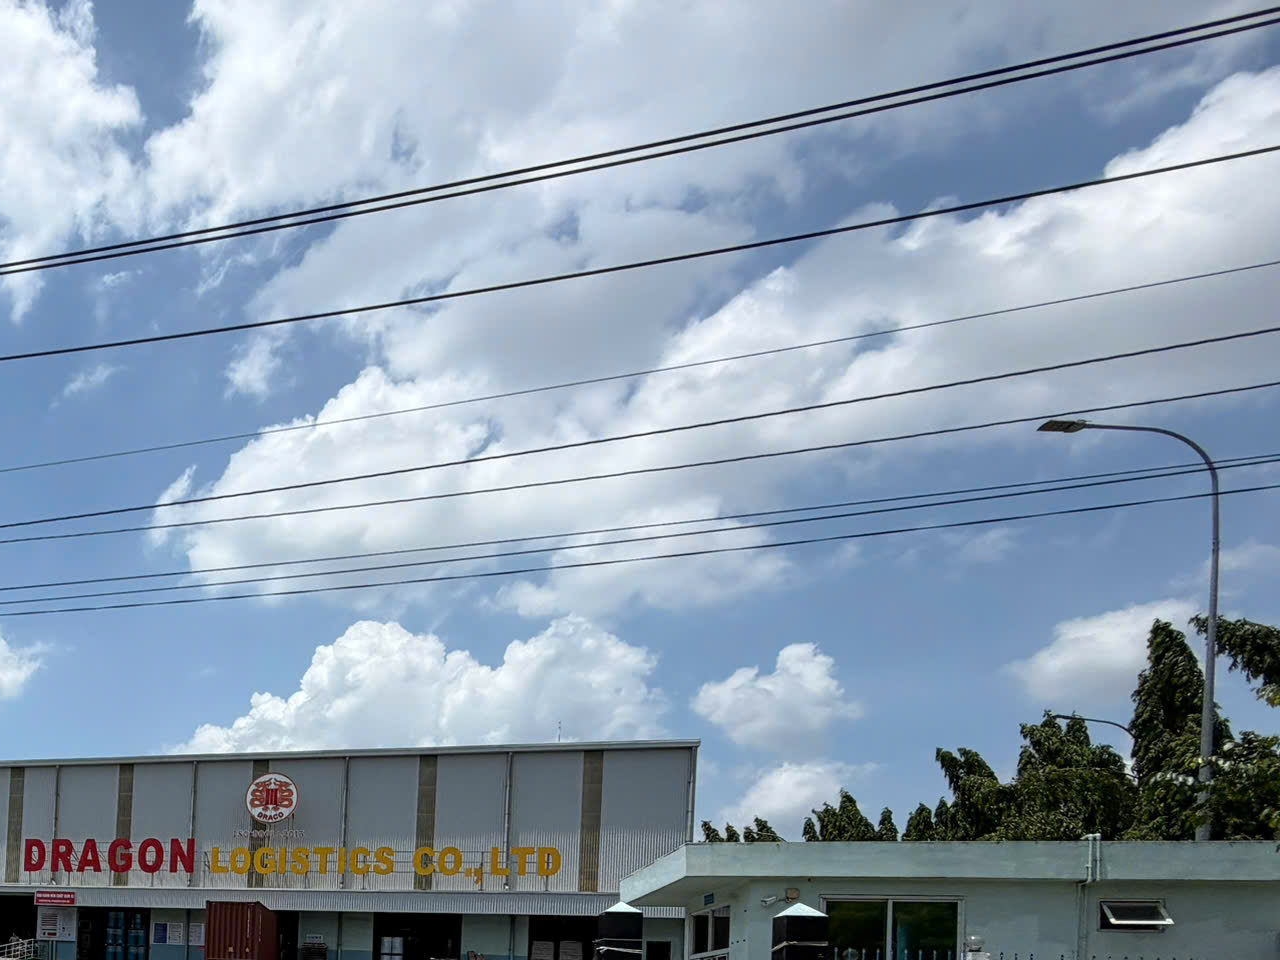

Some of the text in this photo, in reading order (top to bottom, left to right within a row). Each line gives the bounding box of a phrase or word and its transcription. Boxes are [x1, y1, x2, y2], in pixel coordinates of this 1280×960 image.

[257, 811, 284, 821] DRACO
[23, 838, 196, 874] DRAGON
[209, 846, 395, 876] LOGISTICS
